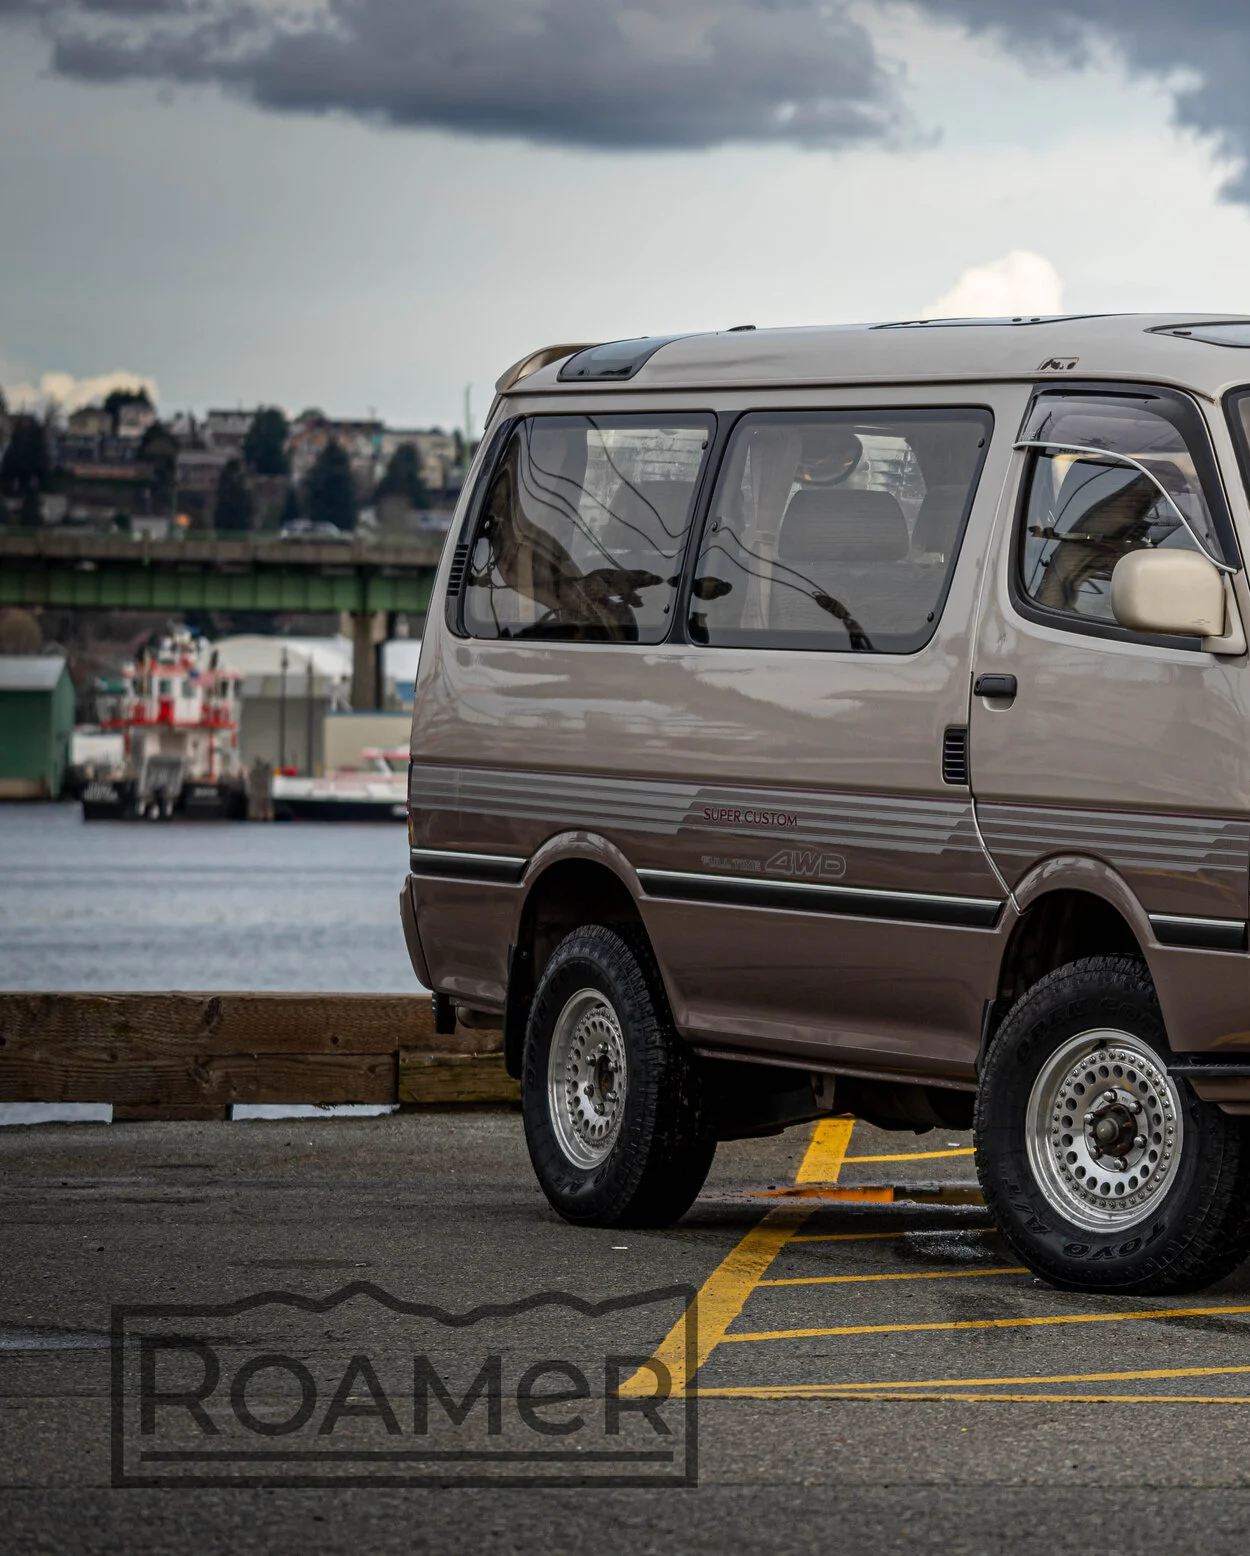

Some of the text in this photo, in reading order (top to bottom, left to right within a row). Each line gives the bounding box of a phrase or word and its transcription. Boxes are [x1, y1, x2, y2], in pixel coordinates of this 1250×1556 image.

[703, 807, 798, 828] SUPER CUSTOM
[701, 849, 847, 879] FULL TIME 4WD
[1062, 1221, 1168, 1261] TOYO
